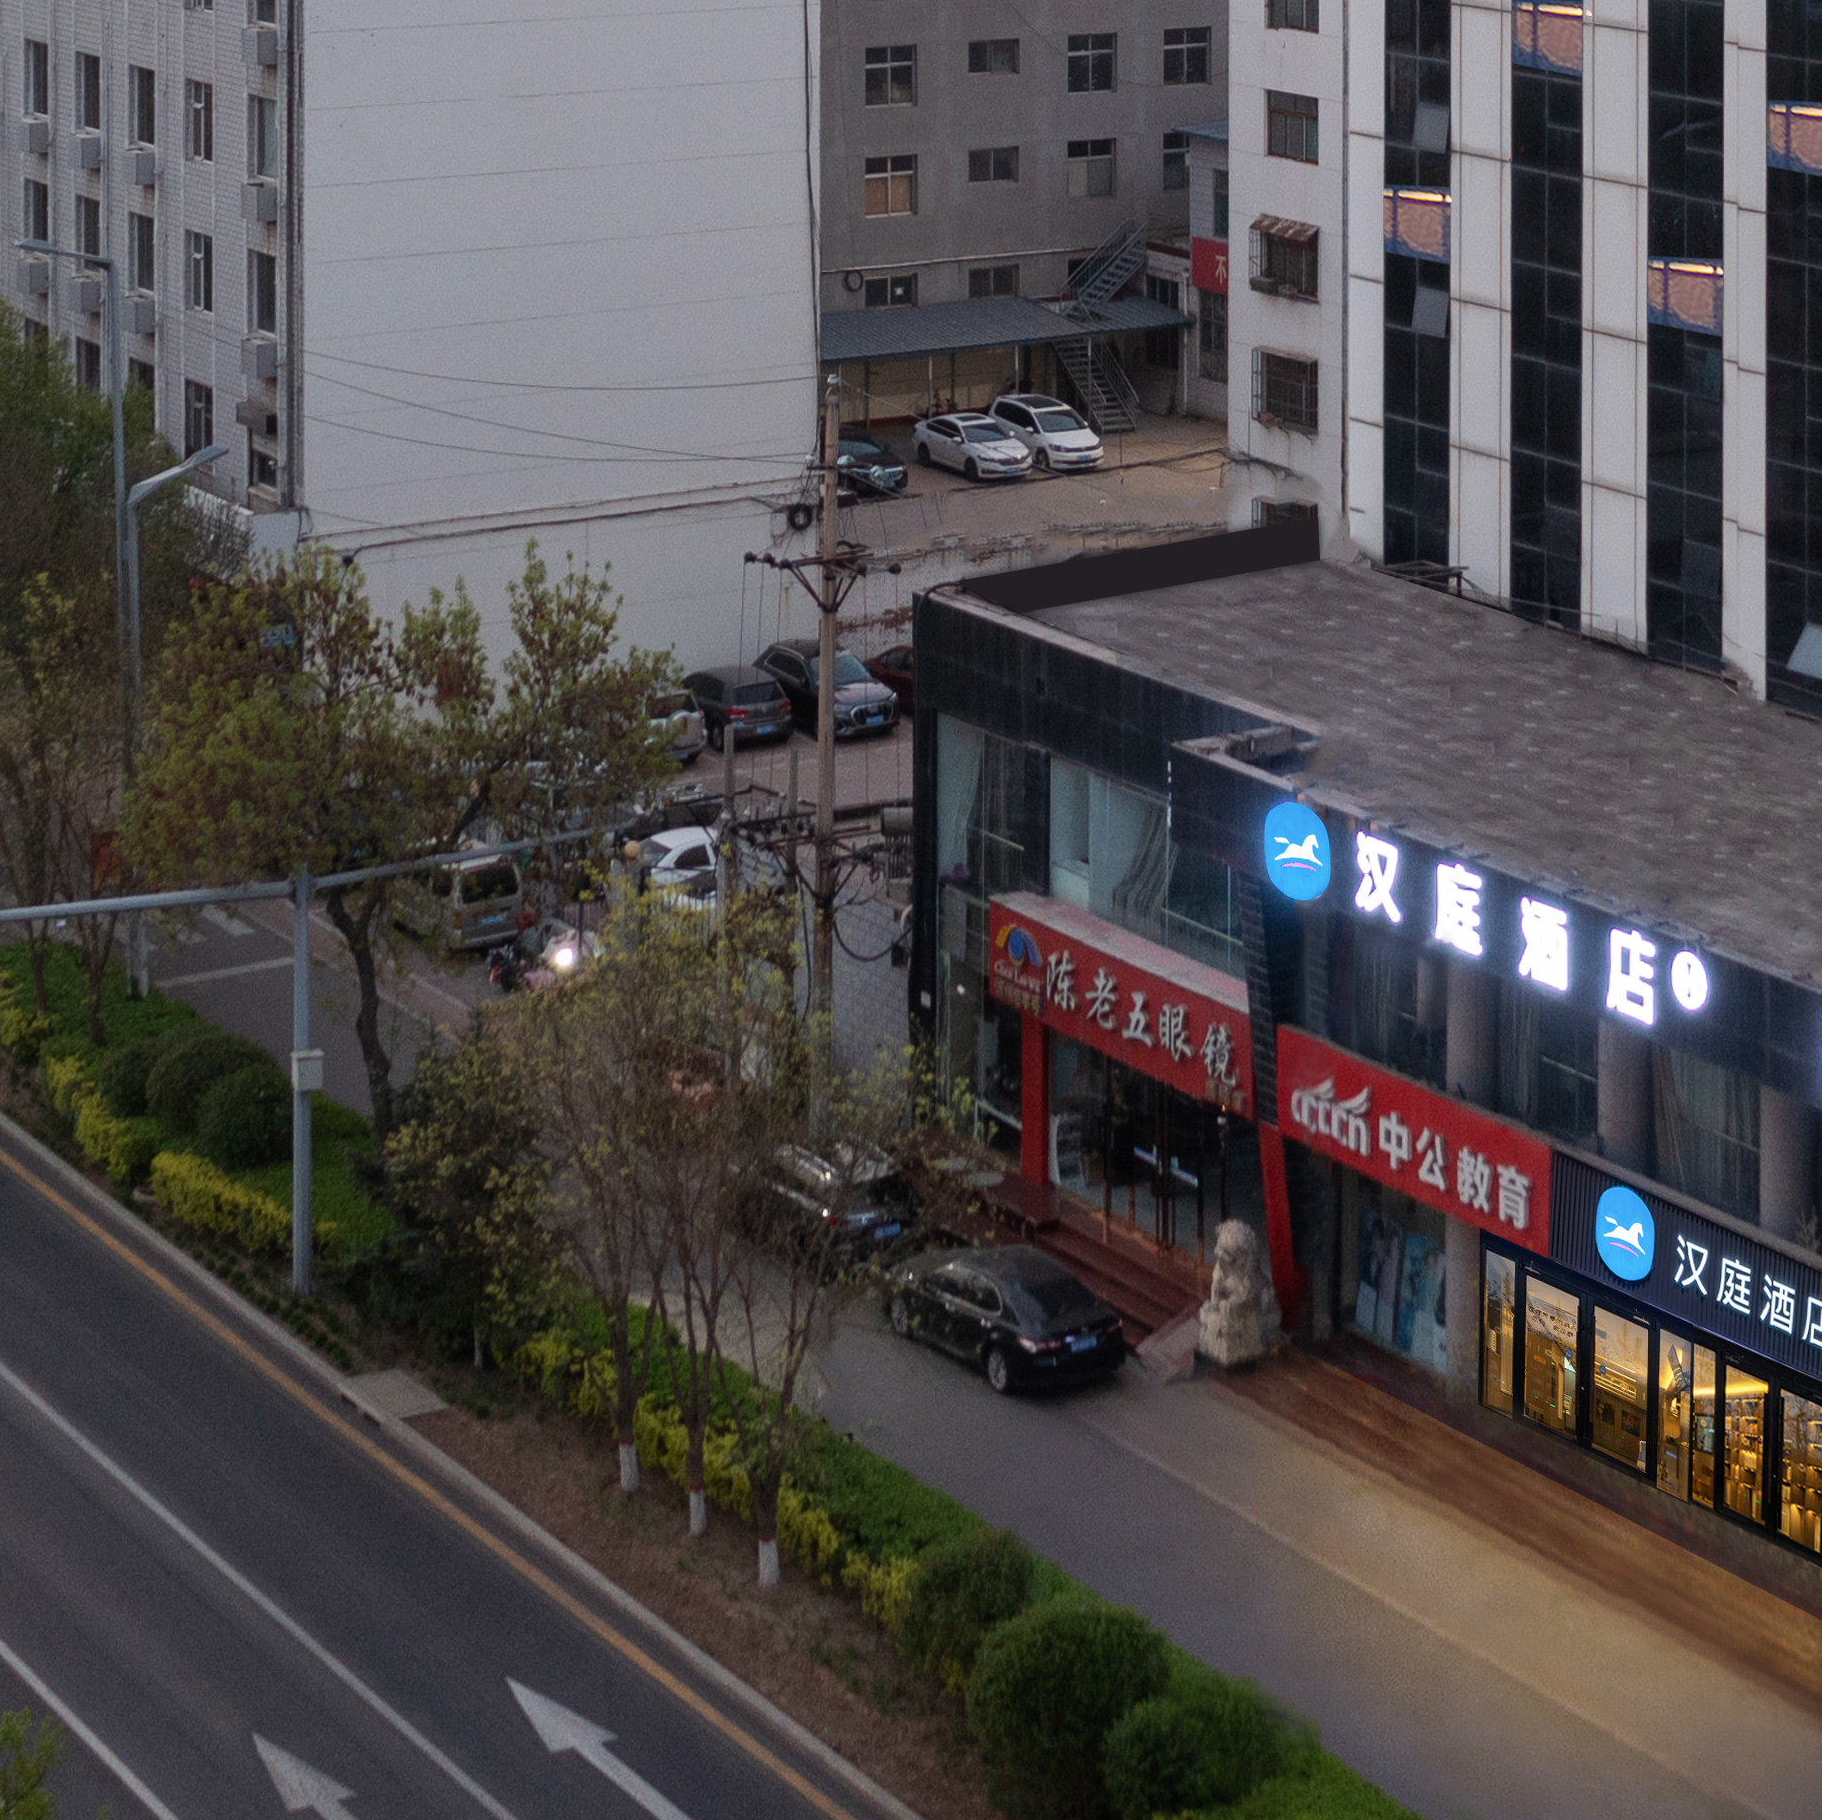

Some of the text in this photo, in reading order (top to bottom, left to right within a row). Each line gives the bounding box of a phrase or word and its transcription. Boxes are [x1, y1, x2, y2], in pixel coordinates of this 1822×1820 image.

[1354, 829, 1657, 1026] 汉庭酒店
[1046, 949, 1237, 1087] 陈老五眼镜
[1379, 1111, 1532, 1230] 中公教育
